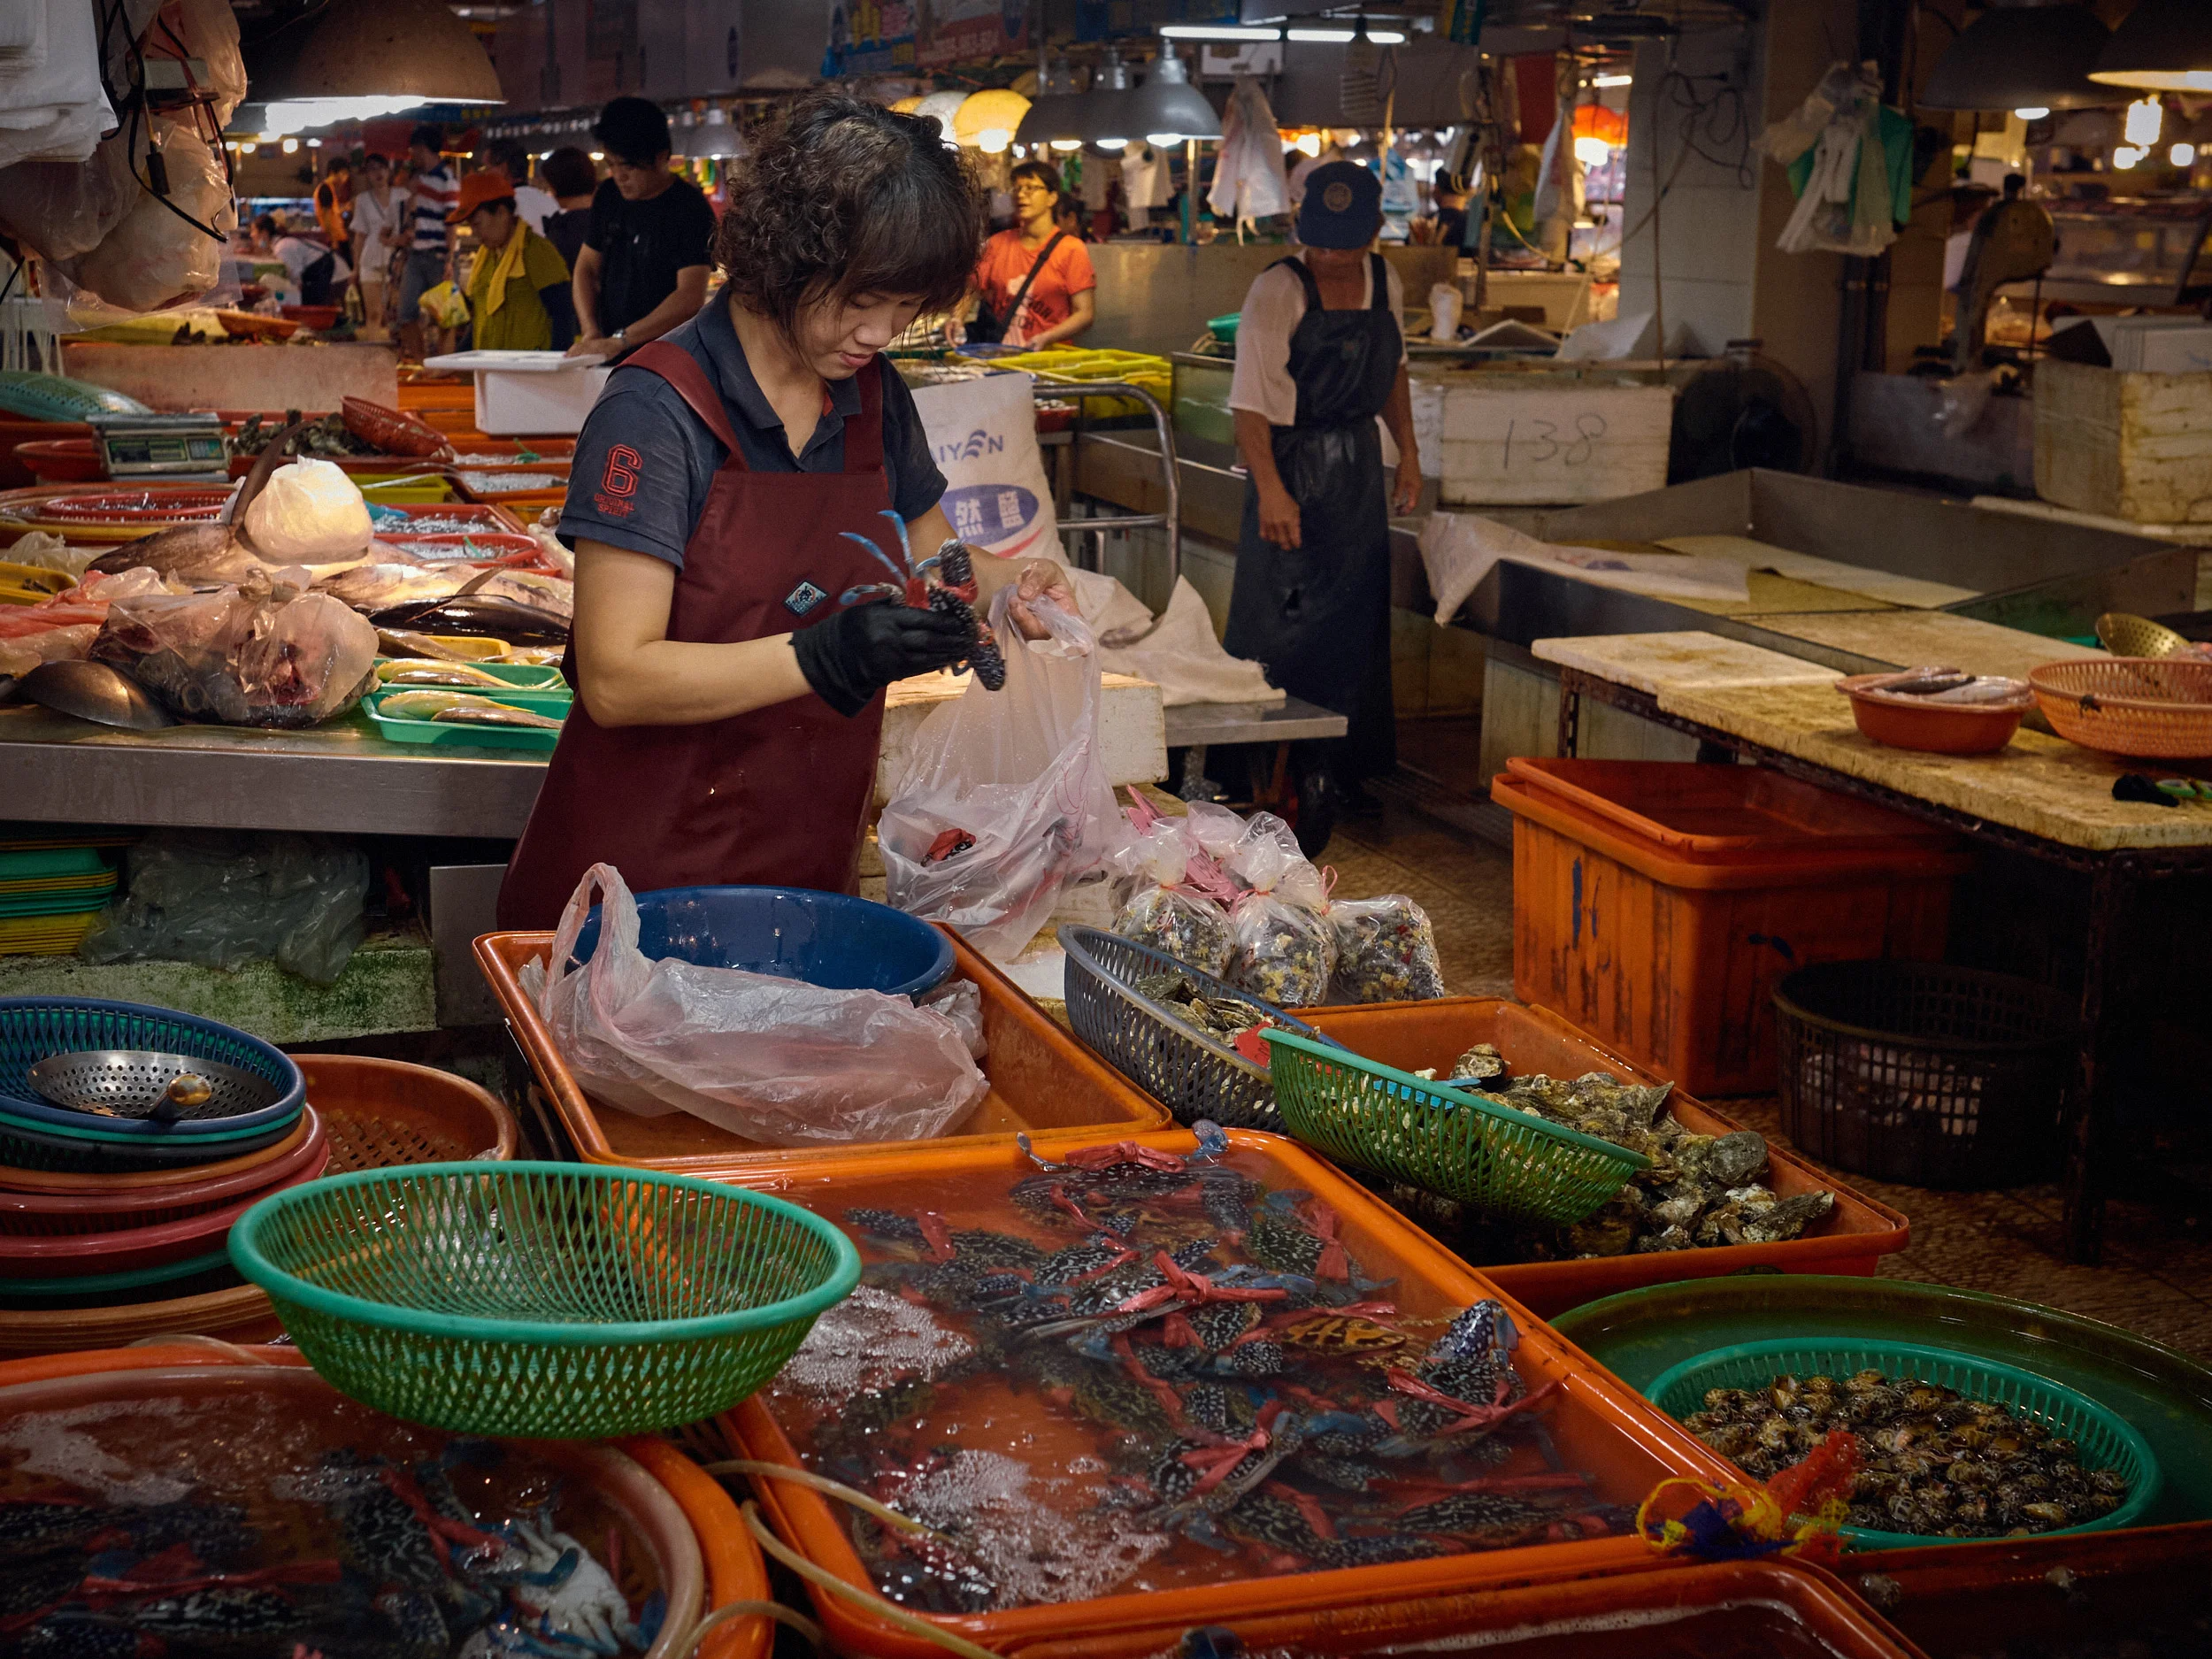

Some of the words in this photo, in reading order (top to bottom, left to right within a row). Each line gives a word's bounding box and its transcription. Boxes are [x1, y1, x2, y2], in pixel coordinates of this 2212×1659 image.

[1503, 412, 1608, 469] 138
[602, 443, 643, 497] 6
[594, 493, 635, 511] ORIGINAL
[597, 503, 629, 518] SPIRIT
